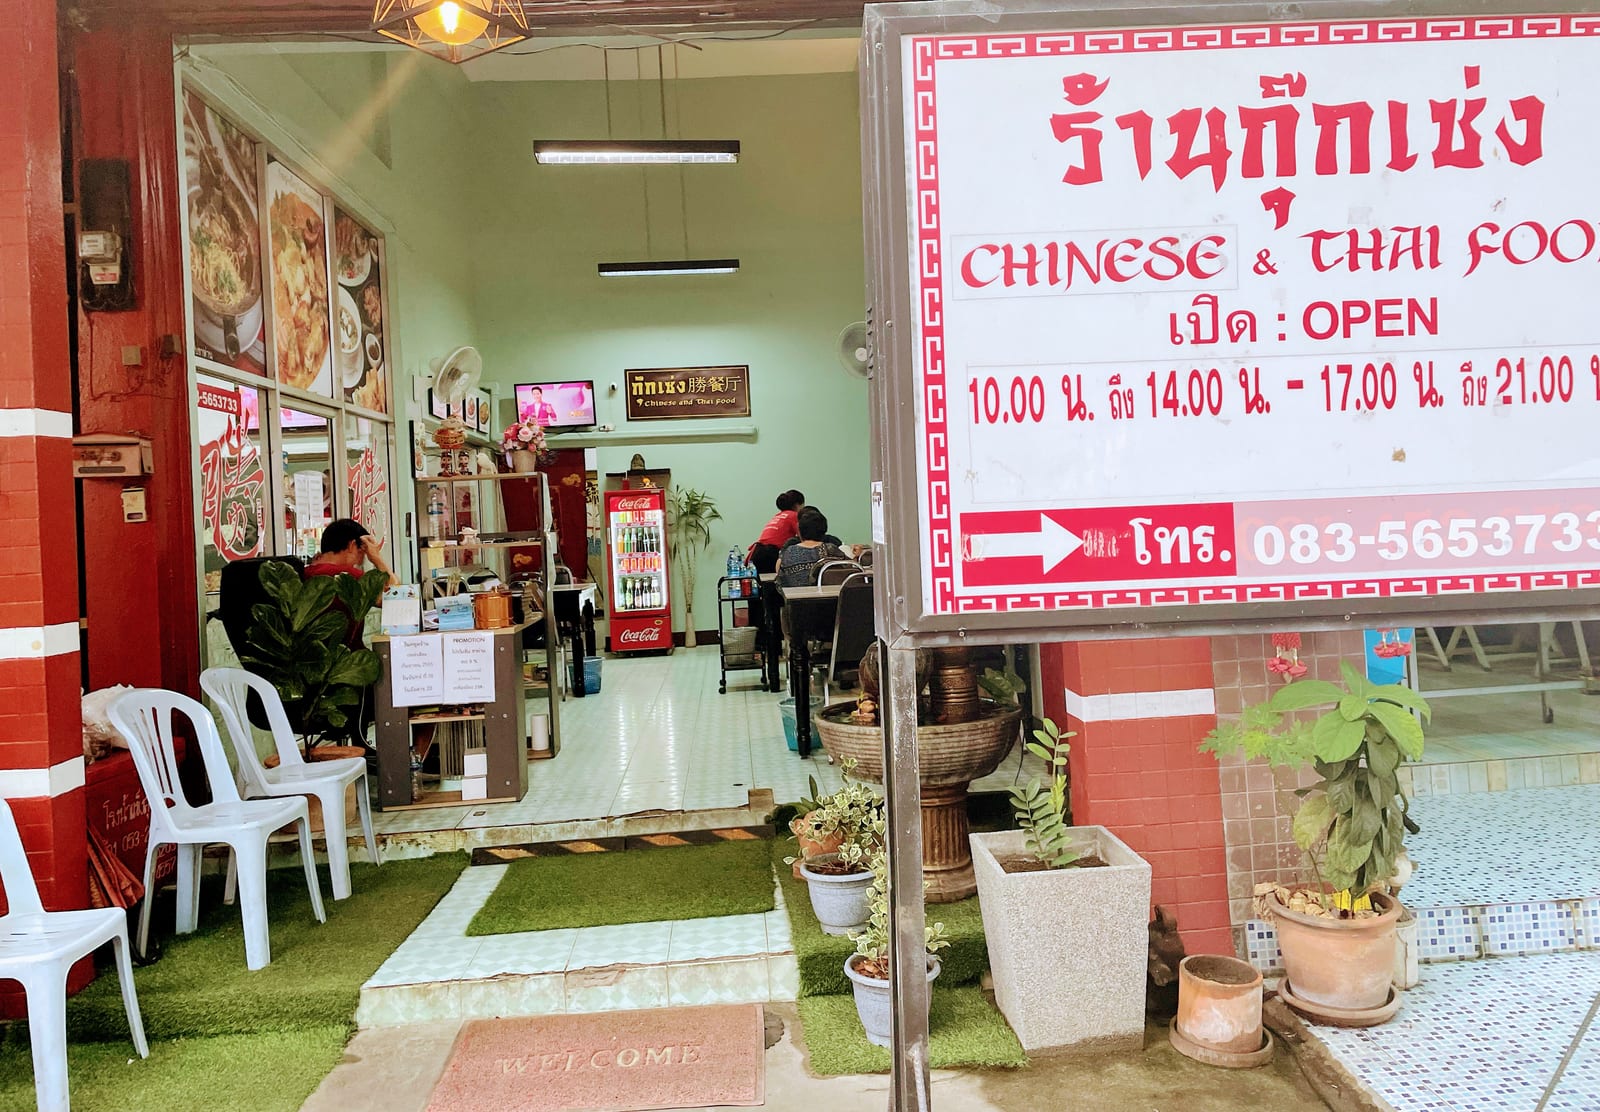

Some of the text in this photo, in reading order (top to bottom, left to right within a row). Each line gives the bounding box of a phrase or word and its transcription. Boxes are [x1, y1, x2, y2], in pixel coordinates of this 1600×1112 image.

[960, 219, 1600, 291] CHINESE & THAI FOO
[1169, 293, 1257, 346] เปิด
[1302, 297, 1439, 341] OPEN
[197, 390, 238, 412] -5653733
[968, 376, 1045, 425] 10.00
[1062, 375, 1095, 422] น.
[1108, 374, 1135, 420] ถึง
[1147, 369, 1223, 418] 14.00
[1238, 367, 1271, 415] น.
[1321, 362, 1397, 412] 17.00
[1412, 359, 1444, 408] น.
[1460, 360, 1488, 407] ถึง
[1495, 355, 1574, 407] 21.00
[1128, 517, 1232, 566] โทร.
[497, 1042, 703, 1075] WELCOME
